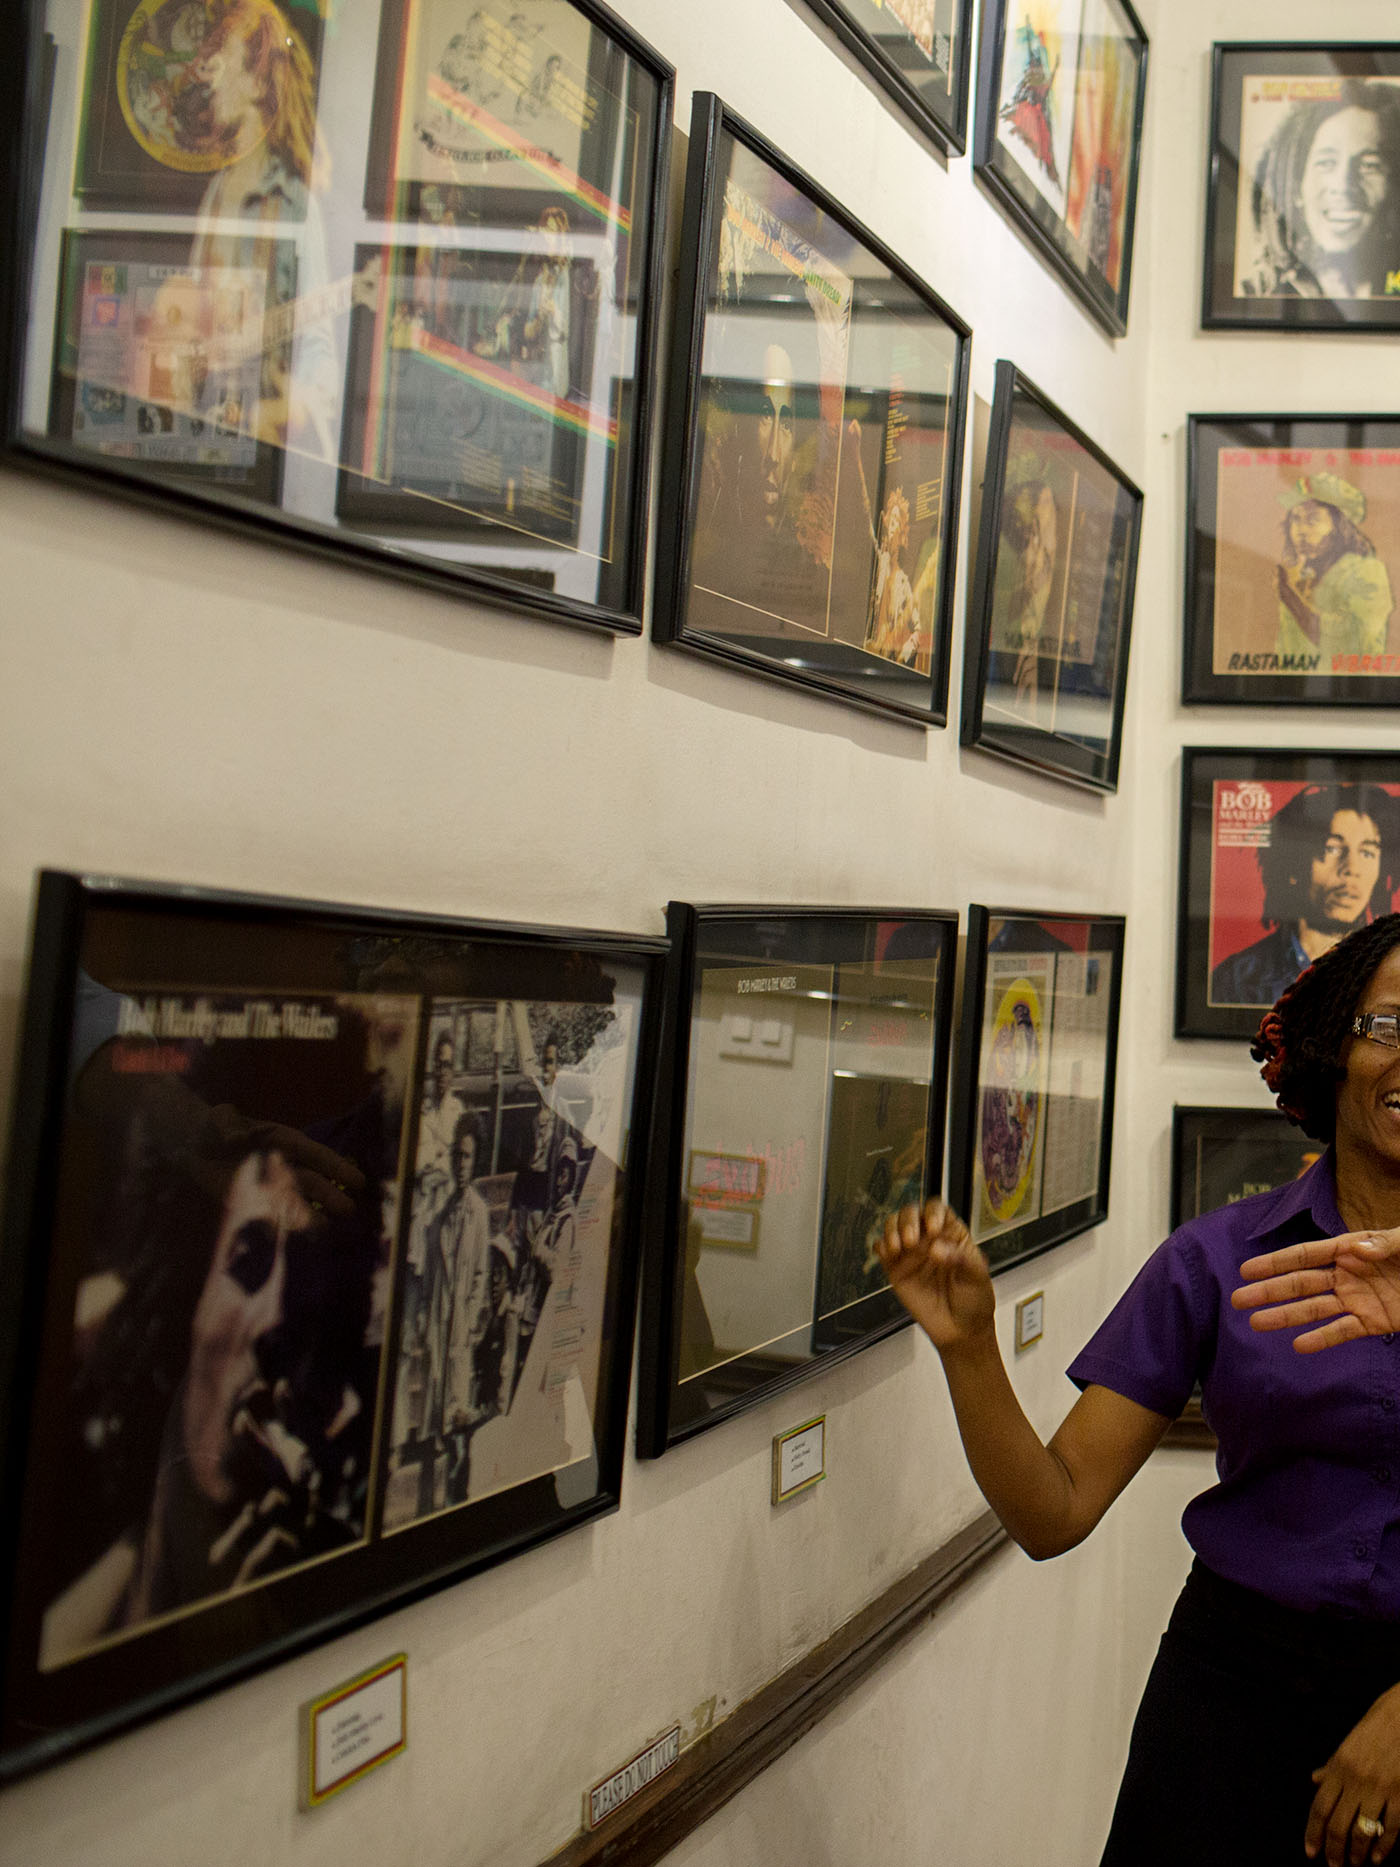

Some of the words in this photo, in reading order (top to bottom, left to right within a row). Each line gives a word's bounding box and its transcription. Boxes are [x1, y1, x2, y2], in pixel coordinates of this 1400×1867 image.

[1228, 652, 1321, 672] RASTAMAN
[1221, 789, 1272, 810] BOB
[737, 979, 750, 994] BOB
[591, 1774, 625, 1824] PLEASE
